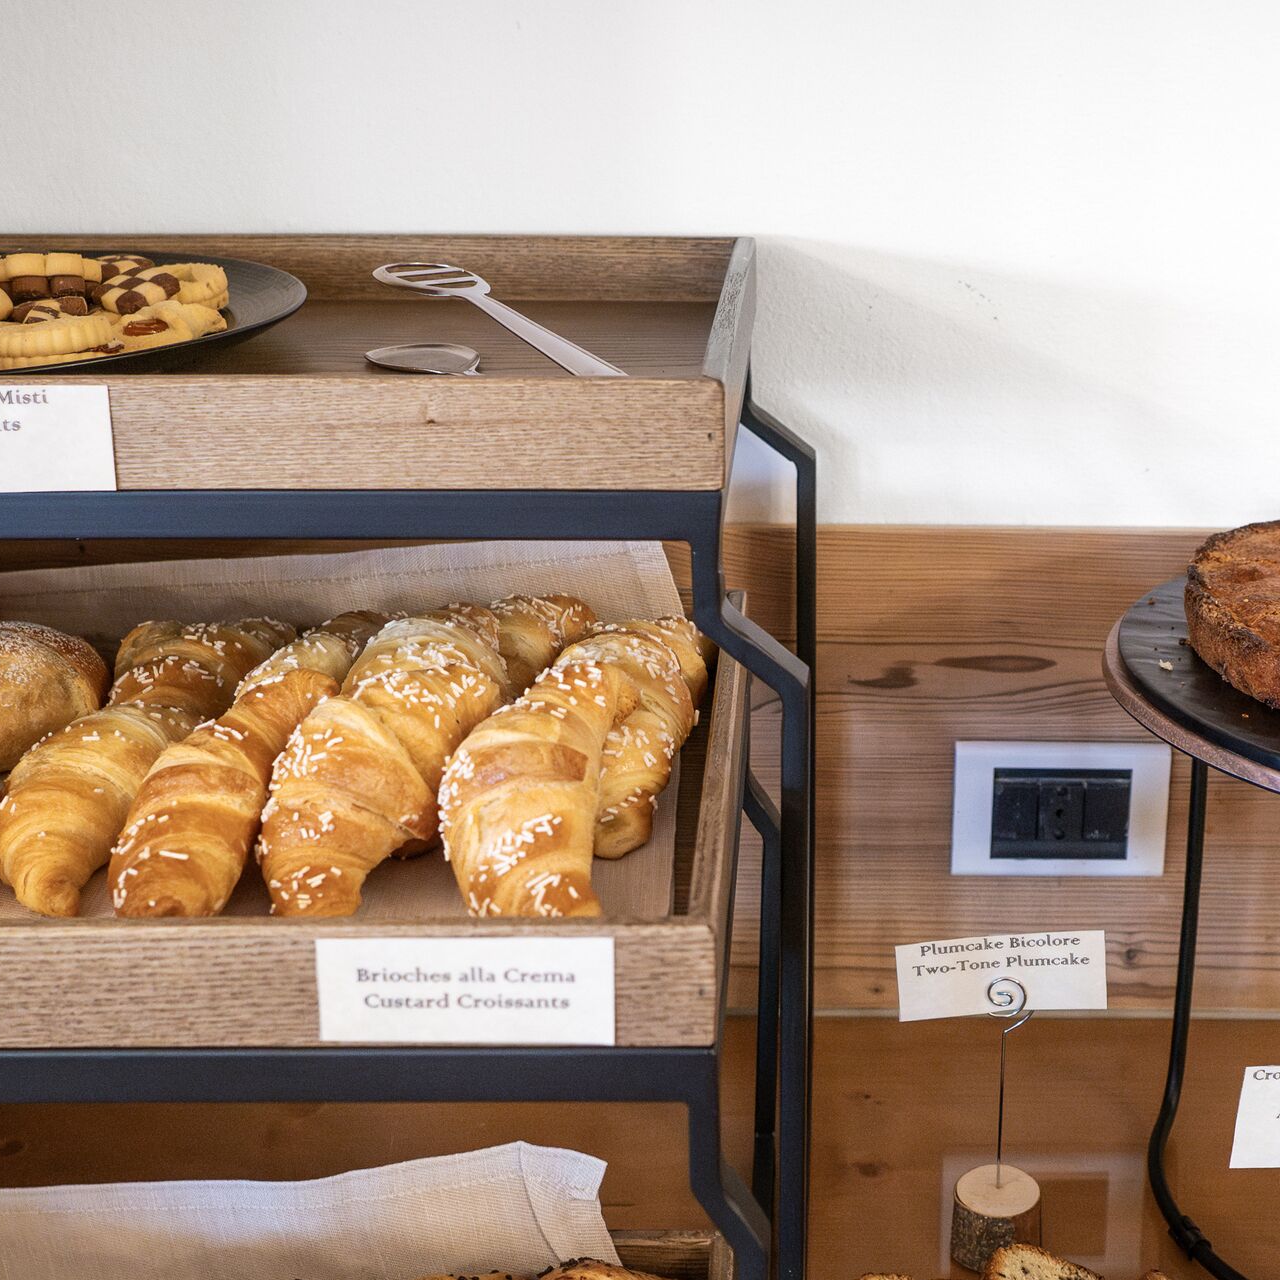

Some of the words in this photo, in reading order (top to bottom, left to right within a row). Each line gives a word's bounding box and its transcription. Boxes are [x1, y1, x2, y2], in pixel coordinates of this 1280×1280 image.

[920, 938, 1004, 957] Plumcake
[1009, 934, 1081, 949] Bicolore
[912, 958, 1000, 977] Two-Tone
[1006, 953, 1090, 968] Plumcake
[356, 967, 452, 983] Brioches
[458, 967, 496, 983] alla
[503, 968, 576, 984] Crema
[364, 993, 449, 1009] Custard
[457, 993, 571, 1009] Croissants
